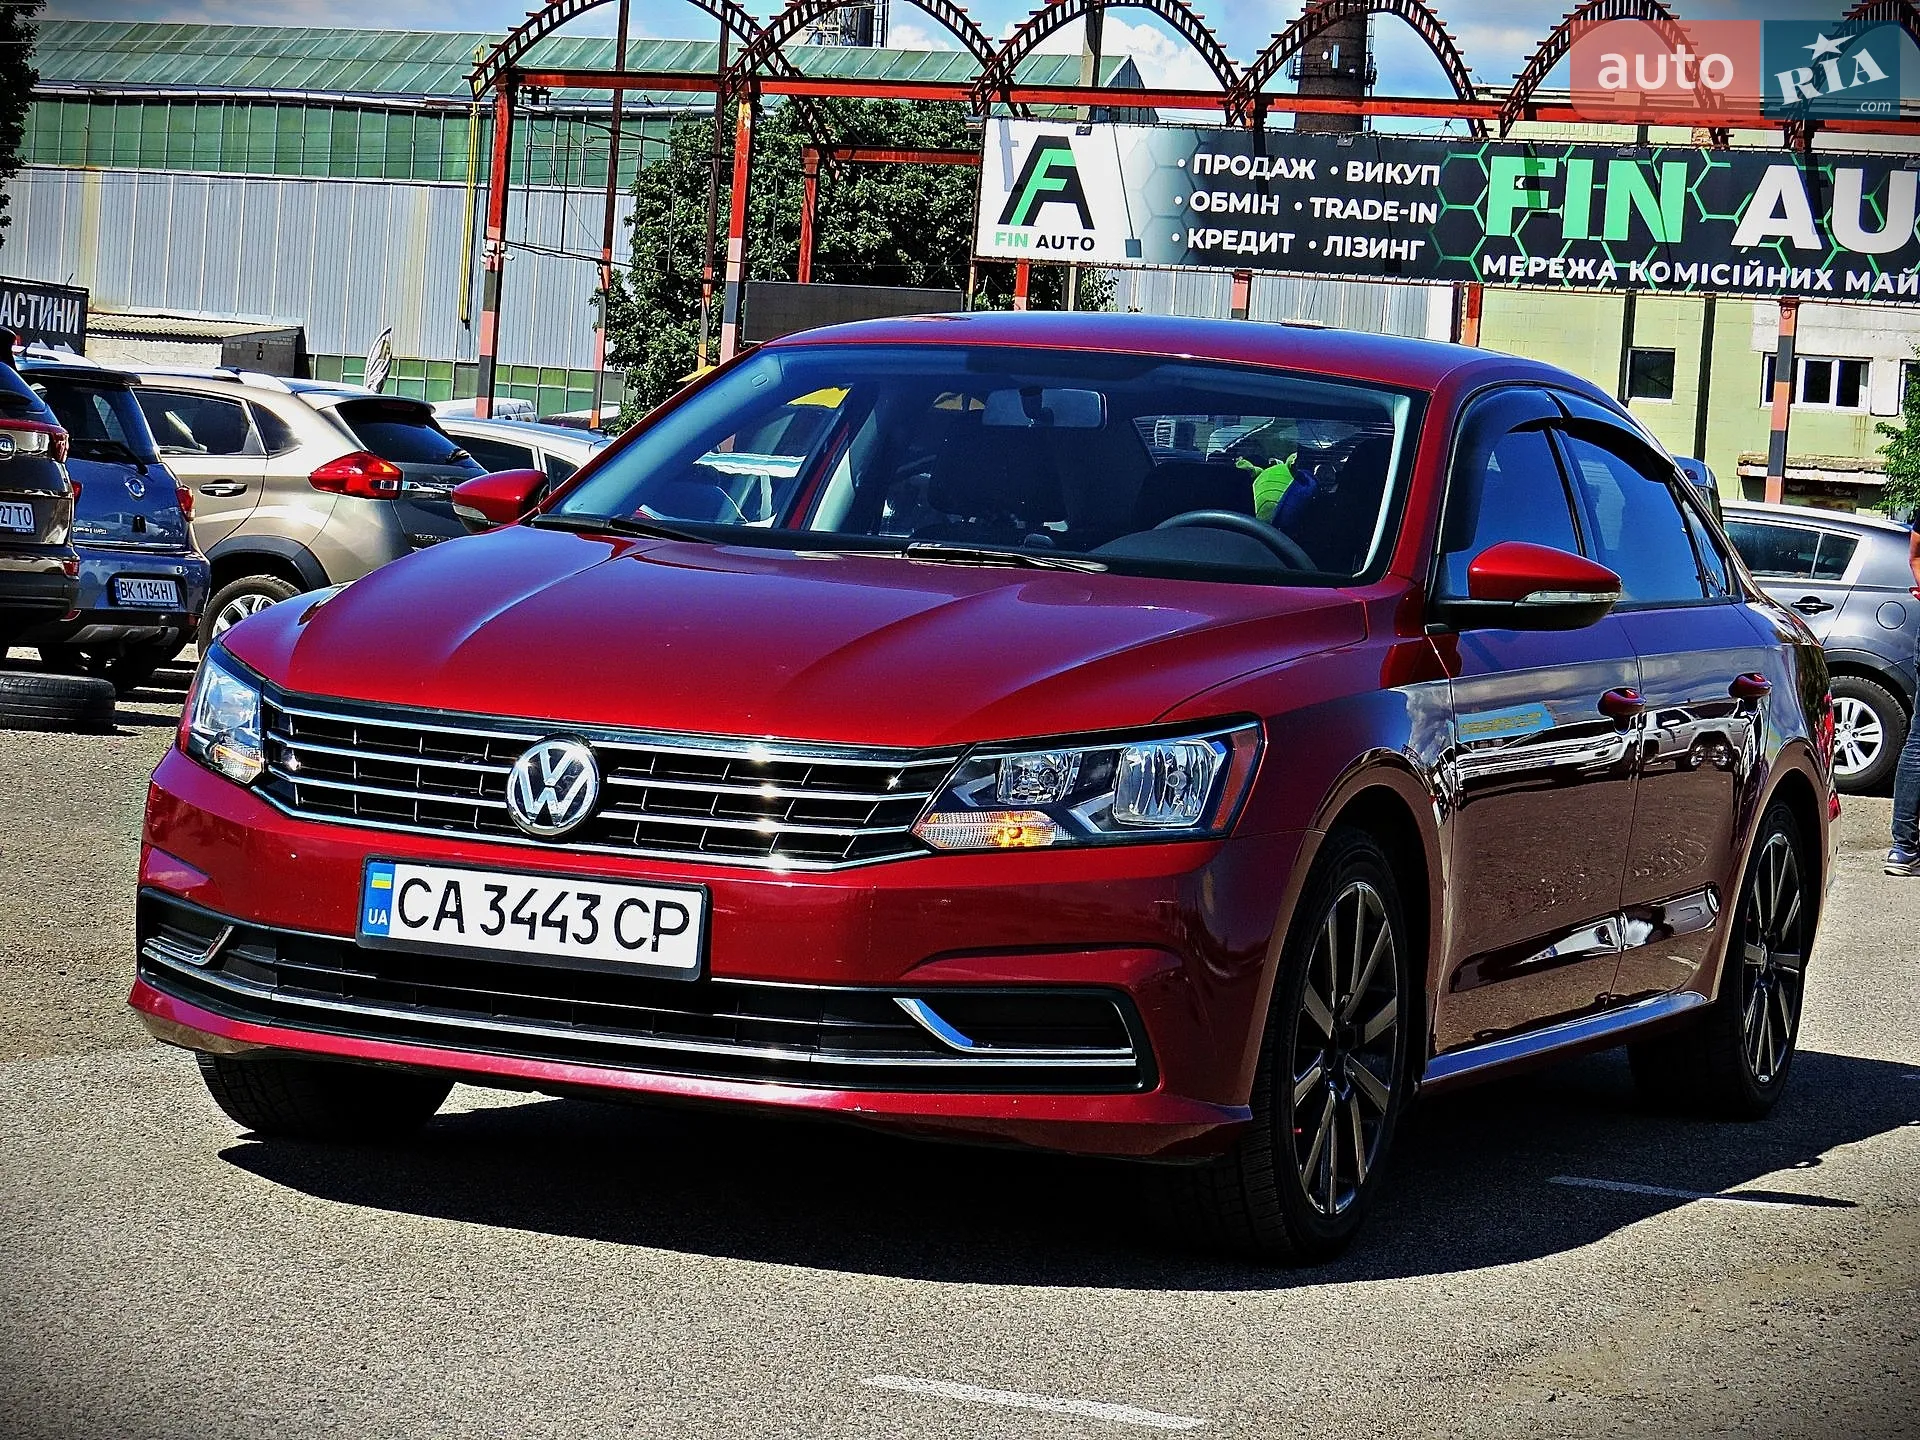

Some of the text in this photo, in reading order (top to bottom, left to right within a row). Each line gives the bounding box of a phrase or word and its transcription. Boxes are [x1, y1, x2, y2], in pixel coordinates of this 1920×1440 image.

[1193, 153, 1317, 180] ПРОДАЖ
[1346, 161, 1440, 187] ВИКУП
[1189, 190, 1280, 216] ОБМІН
[1309, 196, 1438, 224] TRADE-IN
[1485, 156, 1687, 244] FIN
[994, 231, 1096, 251] FIN AUTO
[1187, 228, 1296, 255] КРЕДИТ
[1323, 235, 1425, 261] ЛІЗИНГ
[1482, 254, 1919, 296] МЕРЕЖА КОМІСІЙНИХ МАЙ
[0, 290, 80, 335] АСТИНИ
[120, 581, 136, 599] BK
[137, 582, 160, 600] 1134
[368, 908, 388, 926] UA
[398, 877, 690, 953] CA 3443 CP
